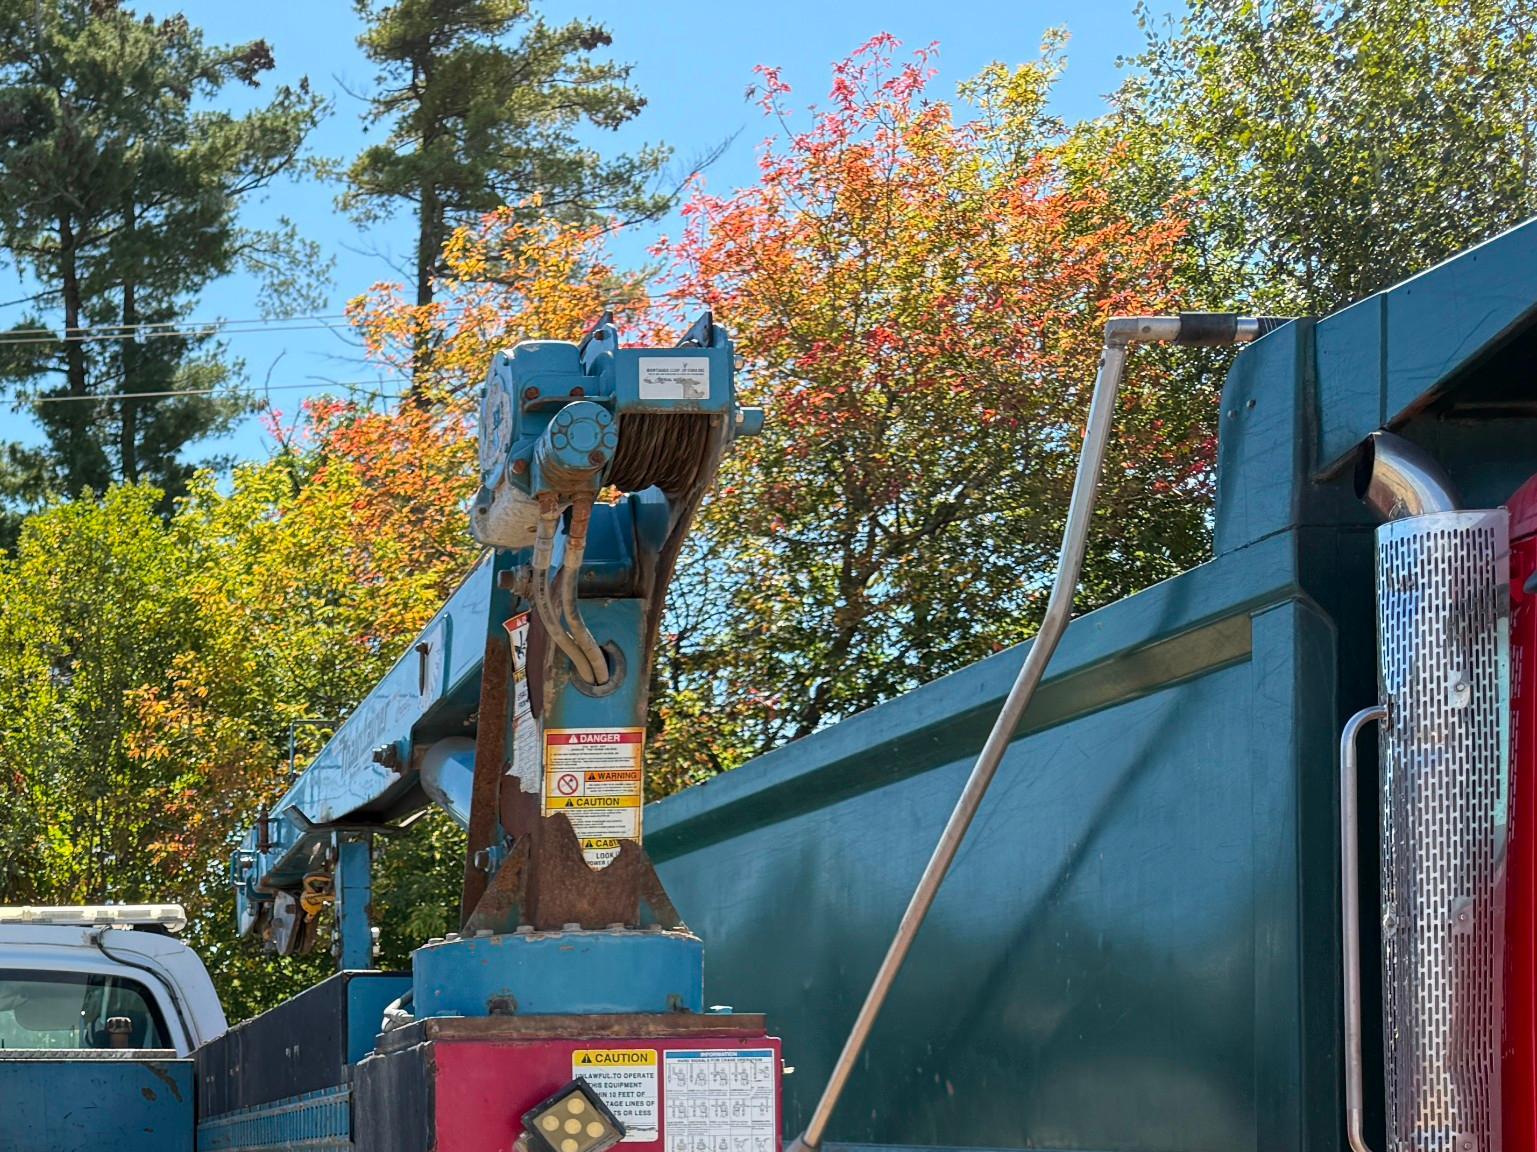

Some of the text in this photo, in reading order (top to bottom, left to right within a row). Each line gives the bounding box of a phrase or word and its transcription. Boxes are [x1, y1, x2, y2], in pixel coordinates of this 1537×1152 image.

[580, 734, 621, 743] DANGER
[598, 772, 637, 780] WARNING
[576, 798, 620, 807] CAUTION
[595, 1053, 648, 1063] CAUTION
